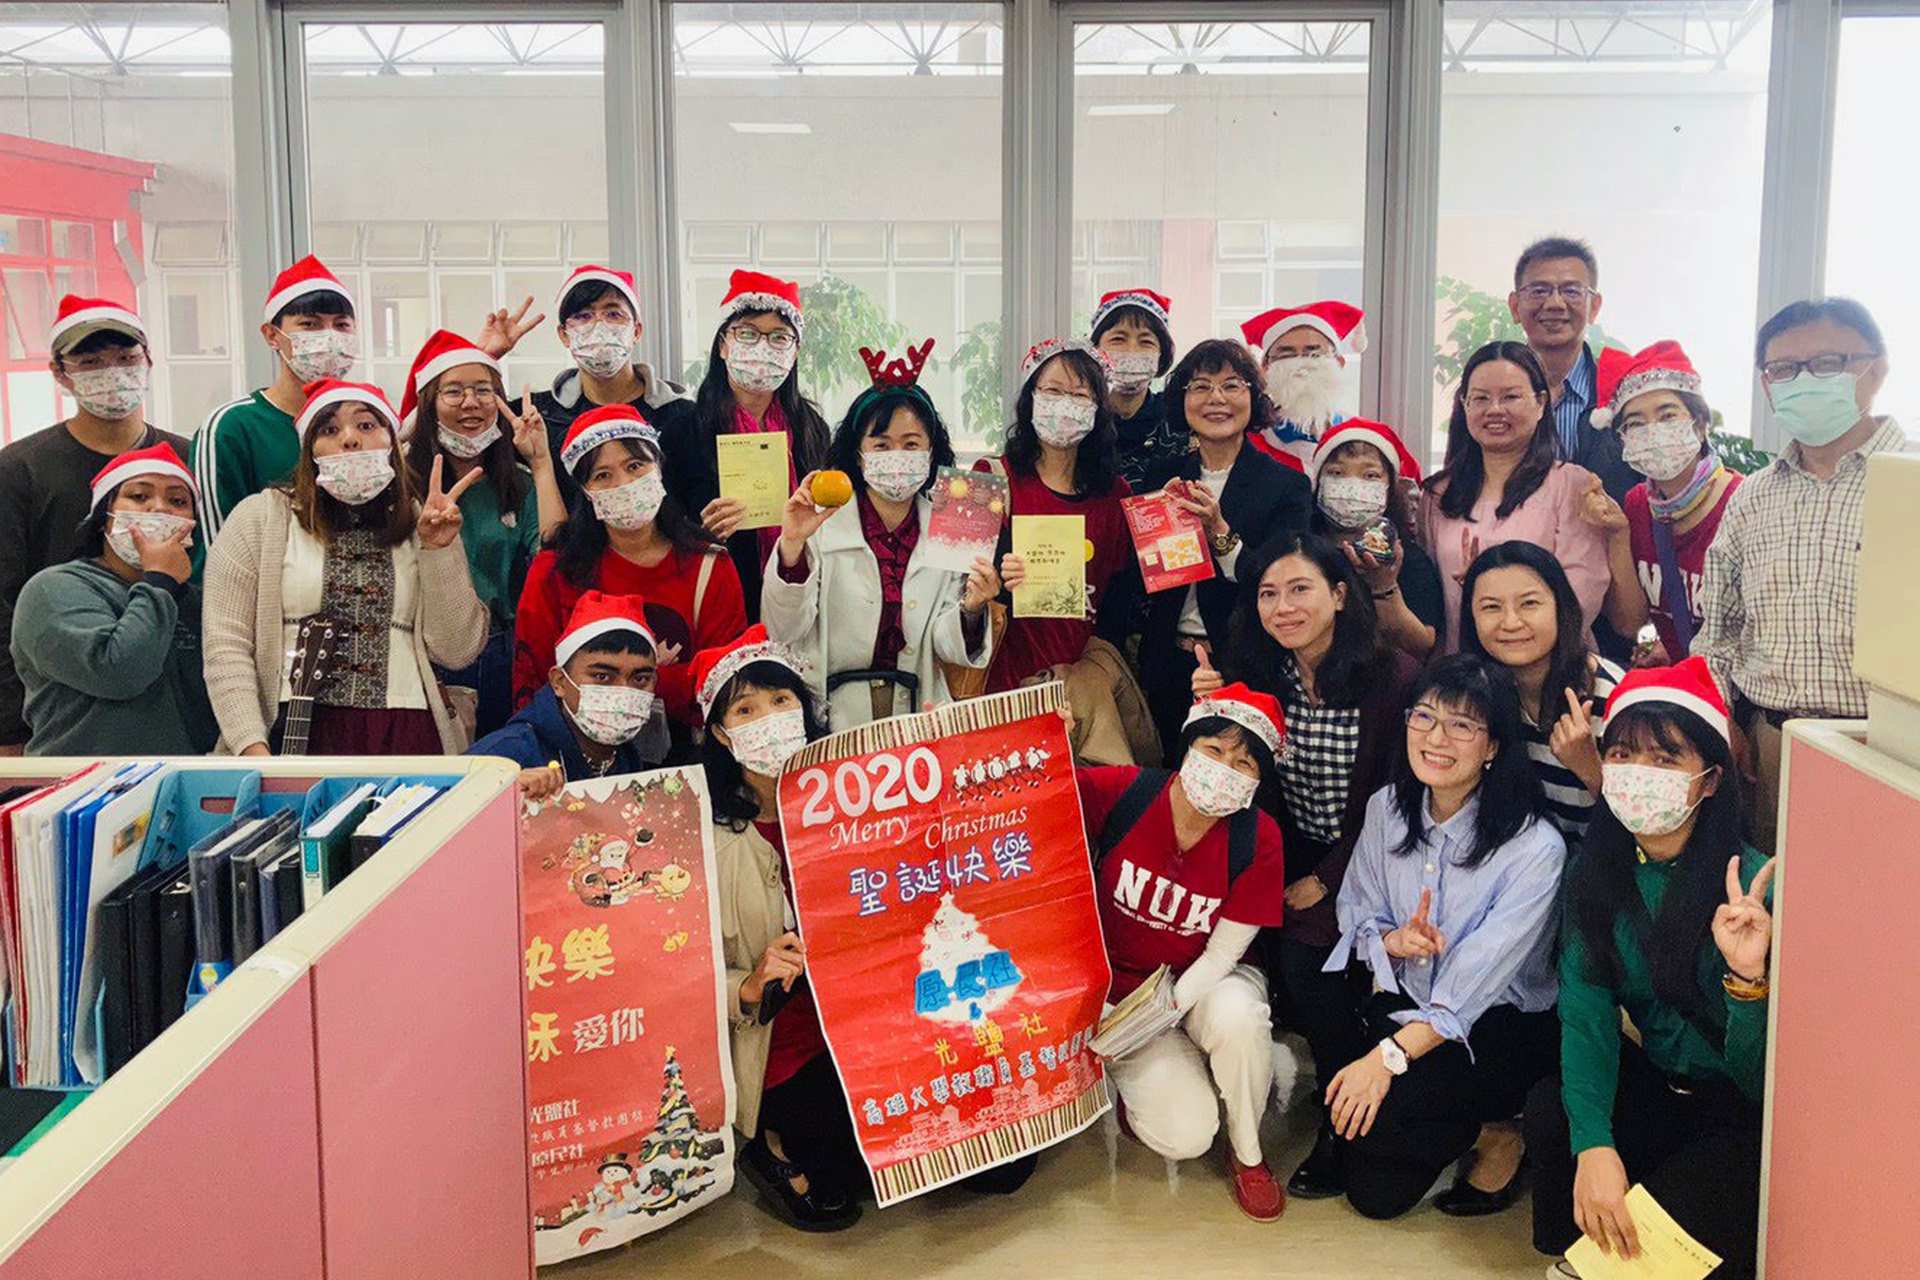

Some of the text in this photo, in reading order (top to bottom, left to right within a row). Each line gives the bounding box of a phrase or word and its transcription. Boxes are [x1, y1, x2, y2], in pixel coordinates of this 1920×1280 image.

[1637, 559, 1706, 618] NK
[797, 746, 943, 829] 2020
[829, 805, 1029, 851] Merry Christmas
[849, 831, 1033, 917] 聖誕快樂
[1112, 858, 1223, 935] NUK
[914, 949, 1024, 1015] 原民社
[933, 1011, 1048, 1067] 光鹽社
